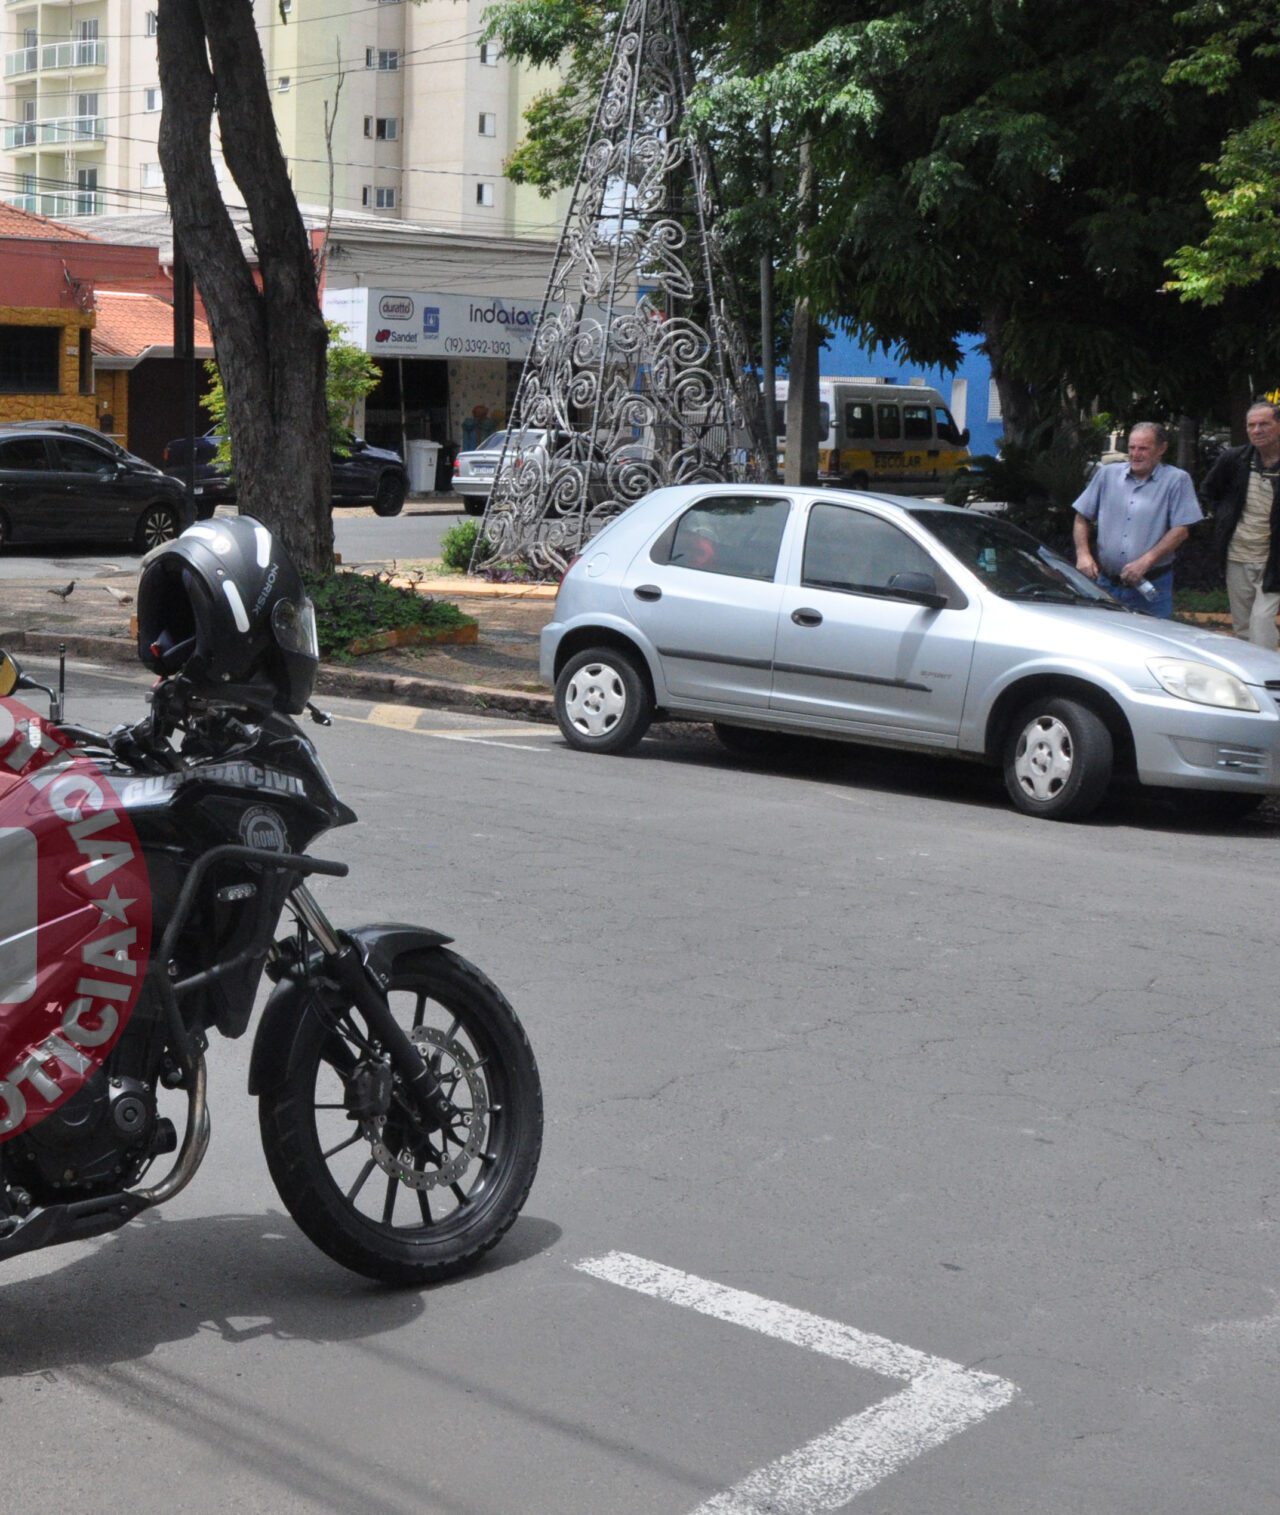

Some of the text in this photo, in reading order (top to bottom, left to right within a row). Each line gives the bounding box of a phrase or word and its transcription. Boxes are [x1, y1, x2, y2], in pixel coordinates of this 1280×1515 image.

[391, 330, 418, 343] Sandet
[444, 335, 511, 356] (19) 3392-1393
[874, 455, 921, 468] ESCOLAR
[251, 562, 280, 616] NORISK
[248, 765, 307, 797] CIVIL
